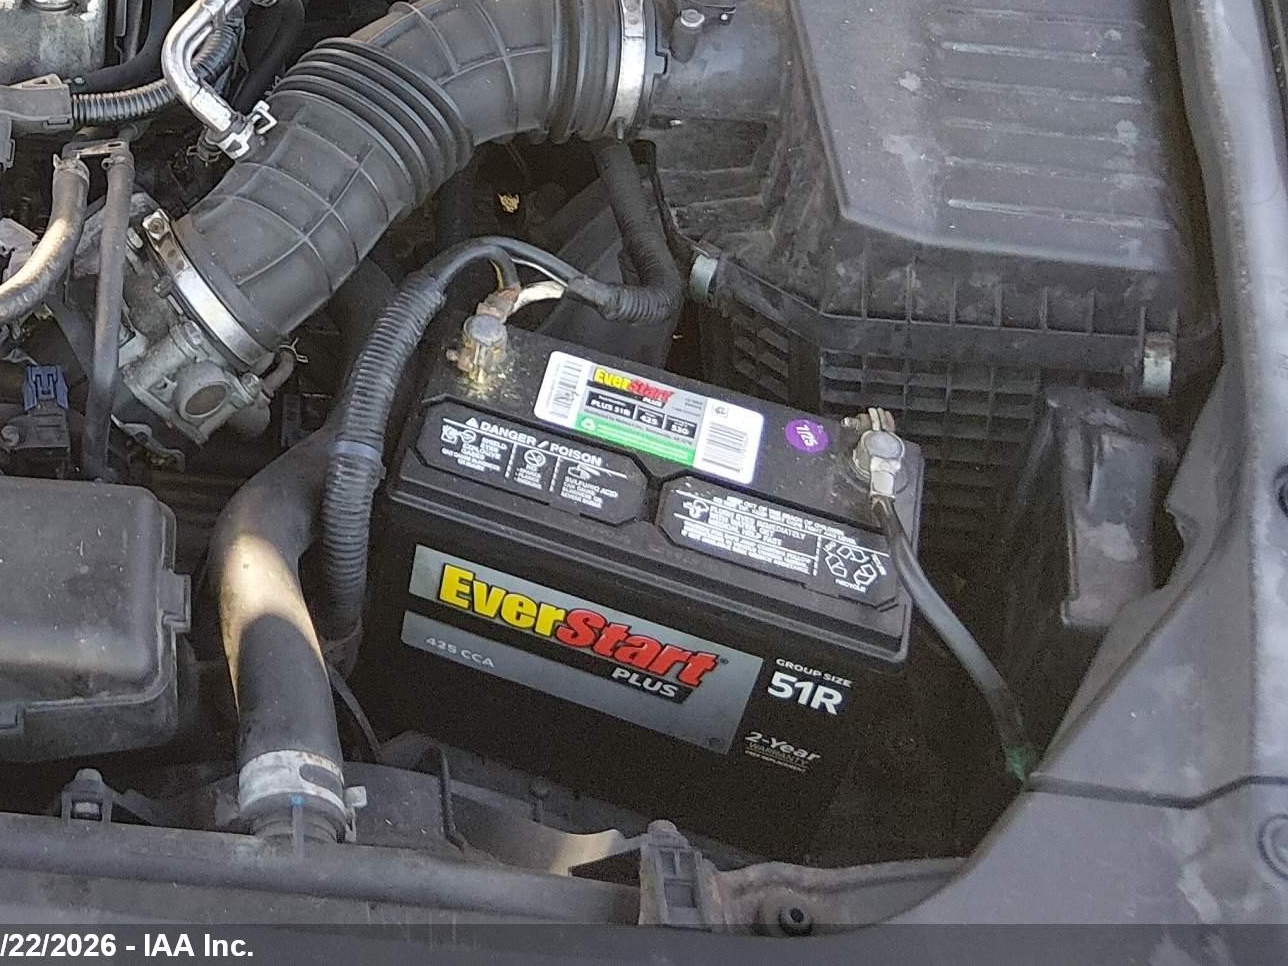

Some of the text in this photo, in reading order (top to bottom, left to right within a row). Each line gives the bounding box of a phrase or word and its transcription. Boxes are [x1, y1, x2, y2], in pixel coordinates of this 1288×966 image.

[593, 366, 676, 402] EverStart
[591, 399, 613, 411] PLUS
[480, 422, 537, 446] DANGER
[550, 443, 602, 466] POISON
[438, 563, 718, 687] EverStart
[426, 637, 495, 668] 425 CCA
[611, 667, 678, 698] PLUS
[776, 658, 853, 688] GROUP SIZE
[767, 671, 844, 715] 51R
[745, 731, 822, 761] 2-Year
